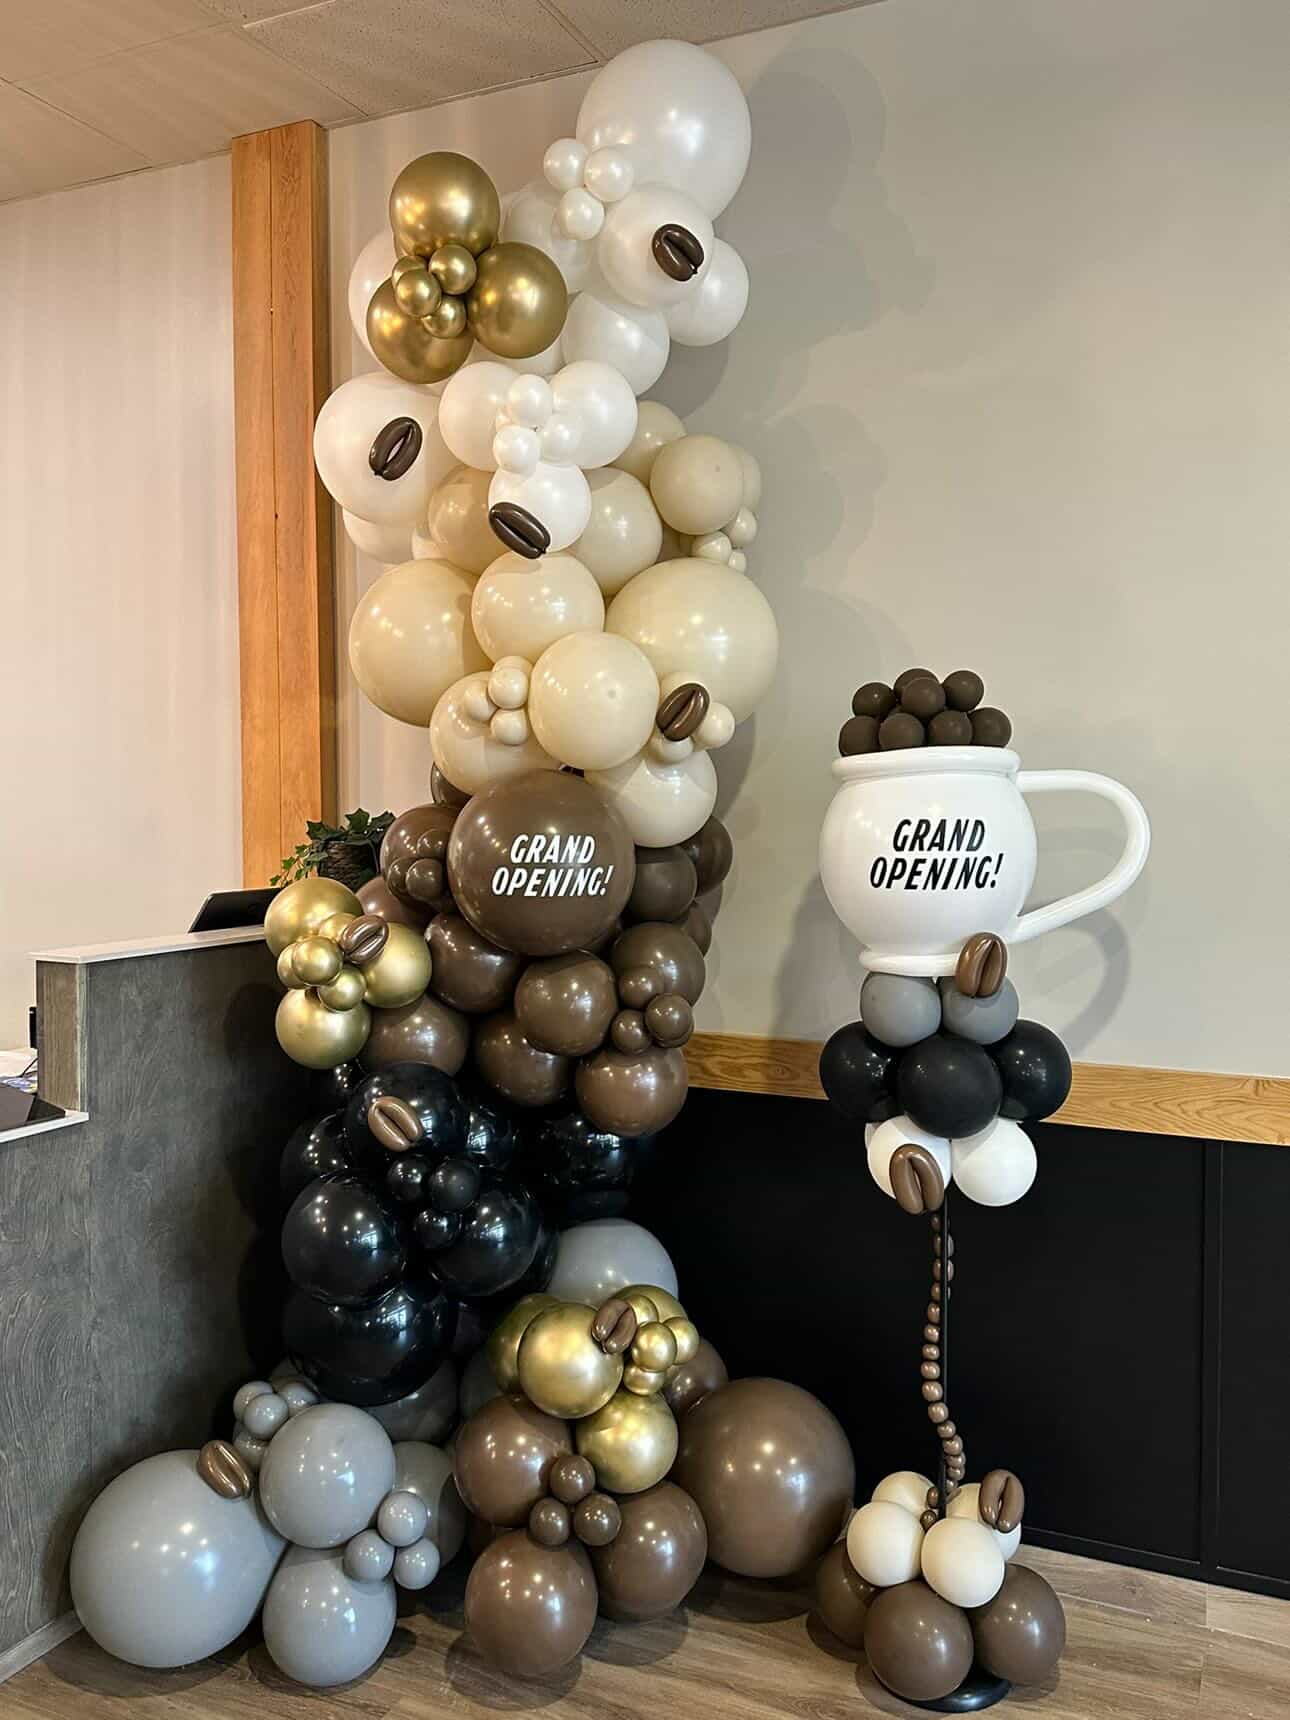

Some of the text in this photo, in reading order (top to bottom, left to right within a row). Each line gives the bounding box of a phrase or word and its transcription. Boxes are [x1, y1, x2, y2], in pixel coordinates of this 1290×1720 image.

[510, 834, 595, 865] GRAND
[892, 818, 986, 852] GRAND
[491, 865, 614, 897] OPENING!
[869, 853, 1004, 891] OPENING!
